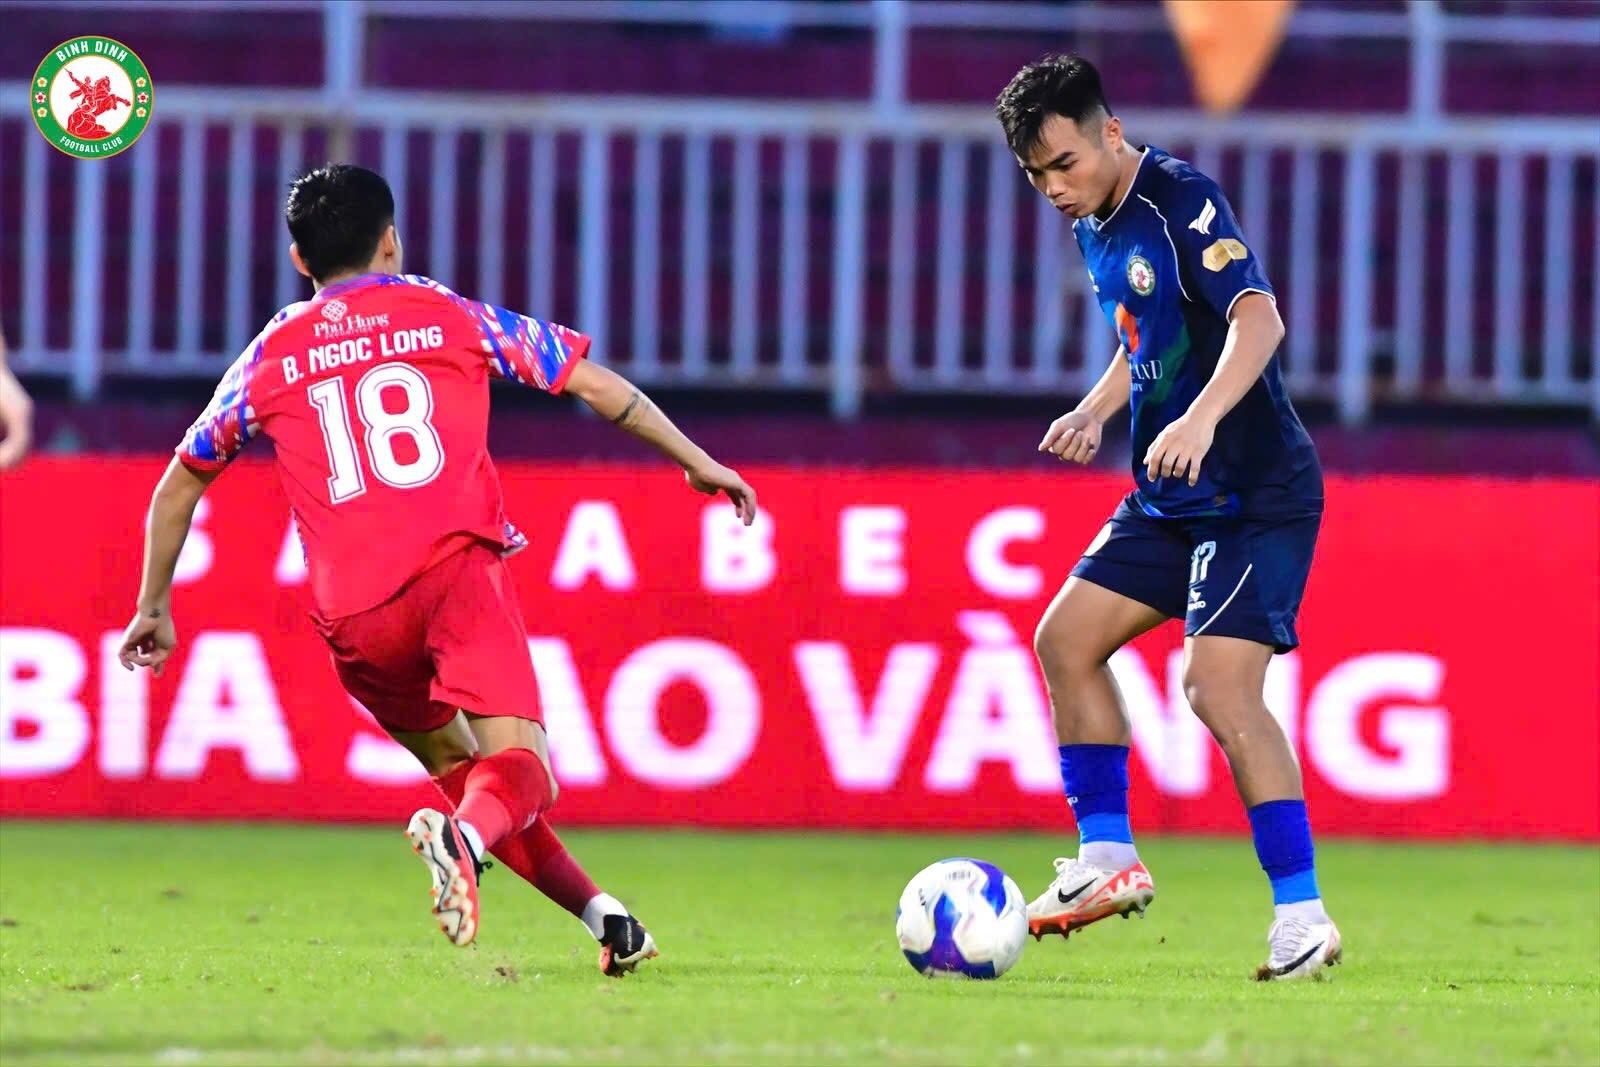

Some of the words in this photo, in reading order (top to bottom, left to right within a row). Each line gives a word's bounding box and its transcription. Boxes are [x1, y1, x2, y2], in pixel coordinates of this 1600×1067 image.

[282, 355, 305, 384] B.
[308, 337, 373, 373] NGOC
[379, 326, 443, 357] LONG
[307, 361, 445, 505] 18
[0, 626, 299, 782] BIA
[795, 610, 1451, 798] VÀNG
